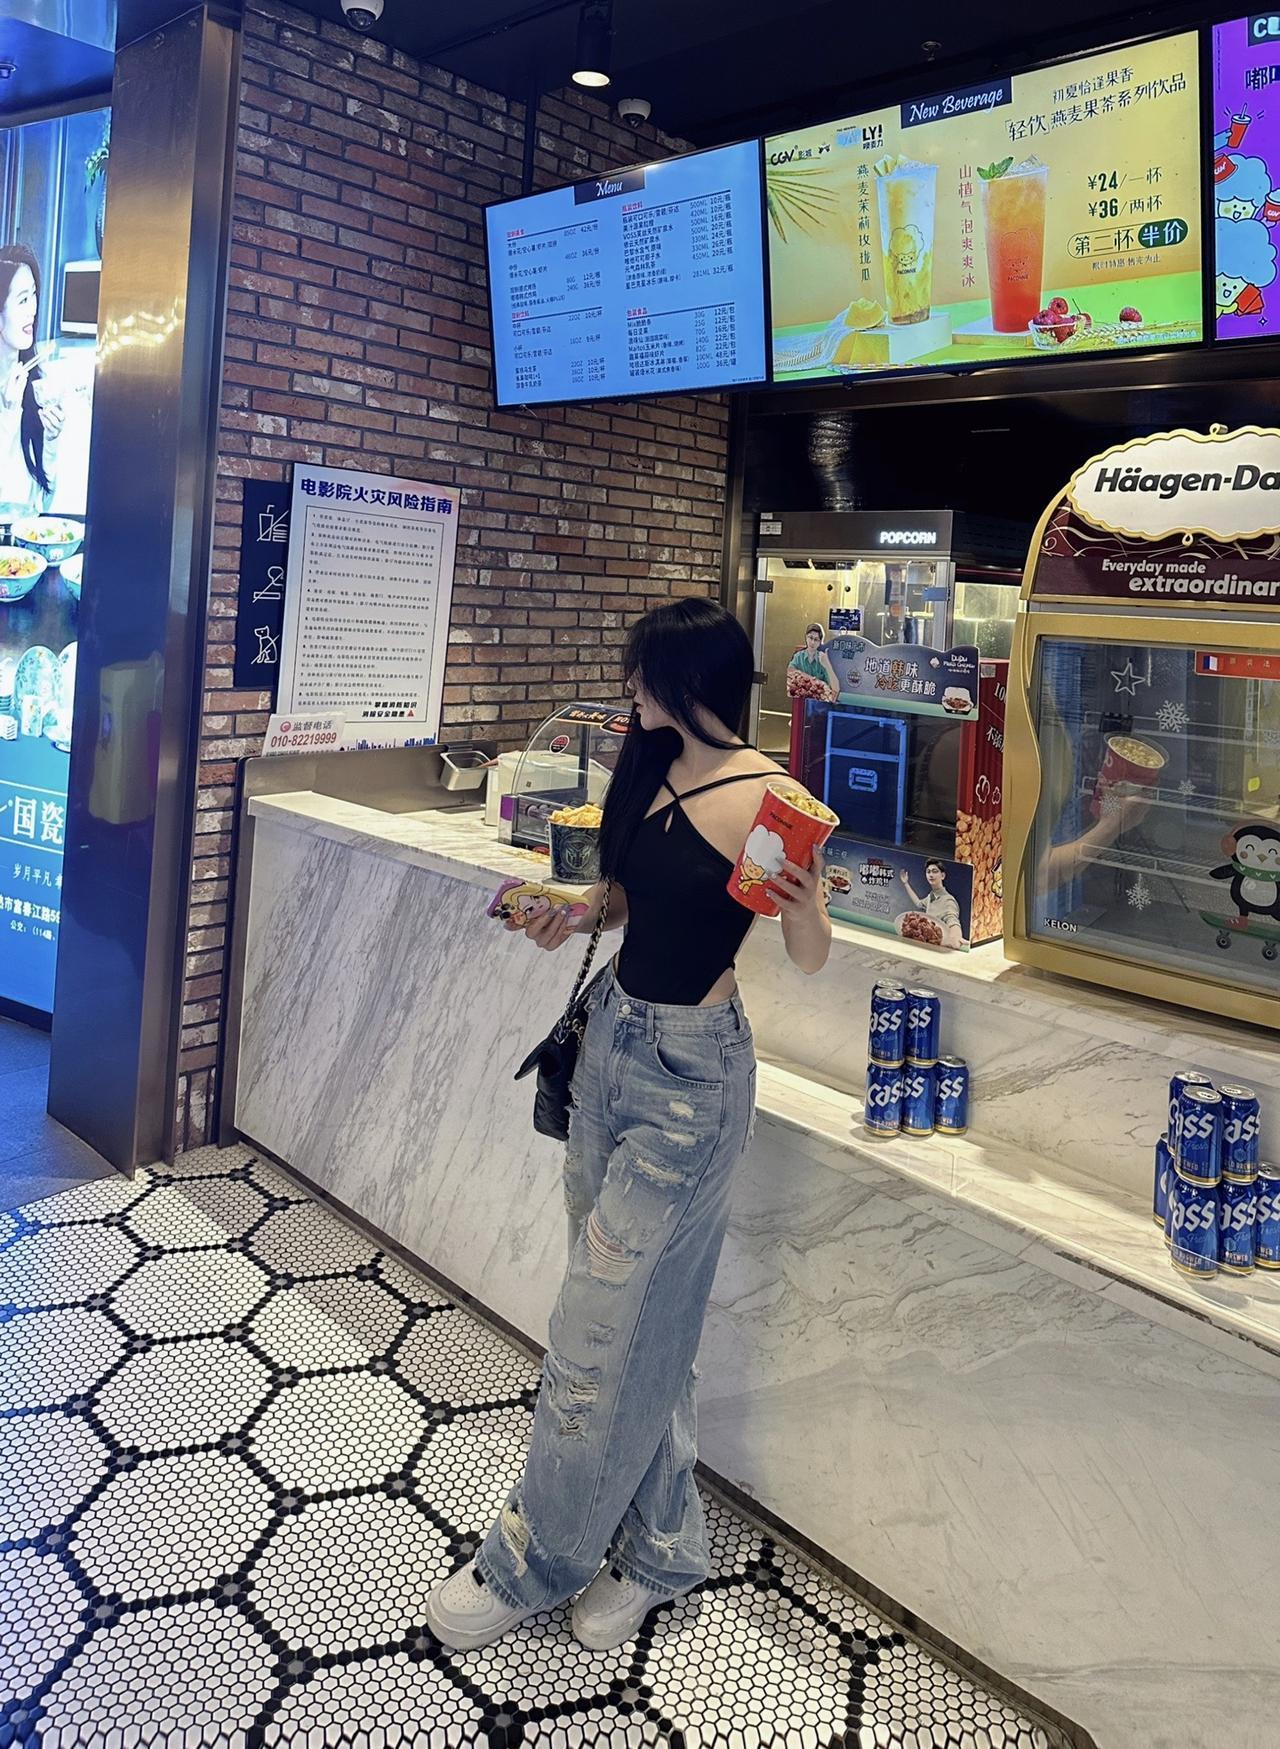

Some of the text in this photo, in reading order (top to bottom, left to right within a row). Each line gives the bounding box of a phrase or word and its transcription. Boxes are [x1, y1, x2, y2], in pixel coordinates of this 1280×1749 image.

[1053, 66, 1134, 104] 初夏恰逢果香
[909, 88, 1004, 122] New Beverage
[596, 181, 623, 198] Menu
[301, 478, 453, 515] 电影院火灾风险指南
[880, 531, 937, 545] POPCORN
[1101, 559, 1206, 575] Everyday made
[1128, 574, 1280, 597] extraordinar
[864, 657, 919, 678] 地道韩味
[292, 719, 334, 732] 监督电话
[270, 732, 337, 748] 010-82219999
[1043, 918, 1077, 933] KELON
